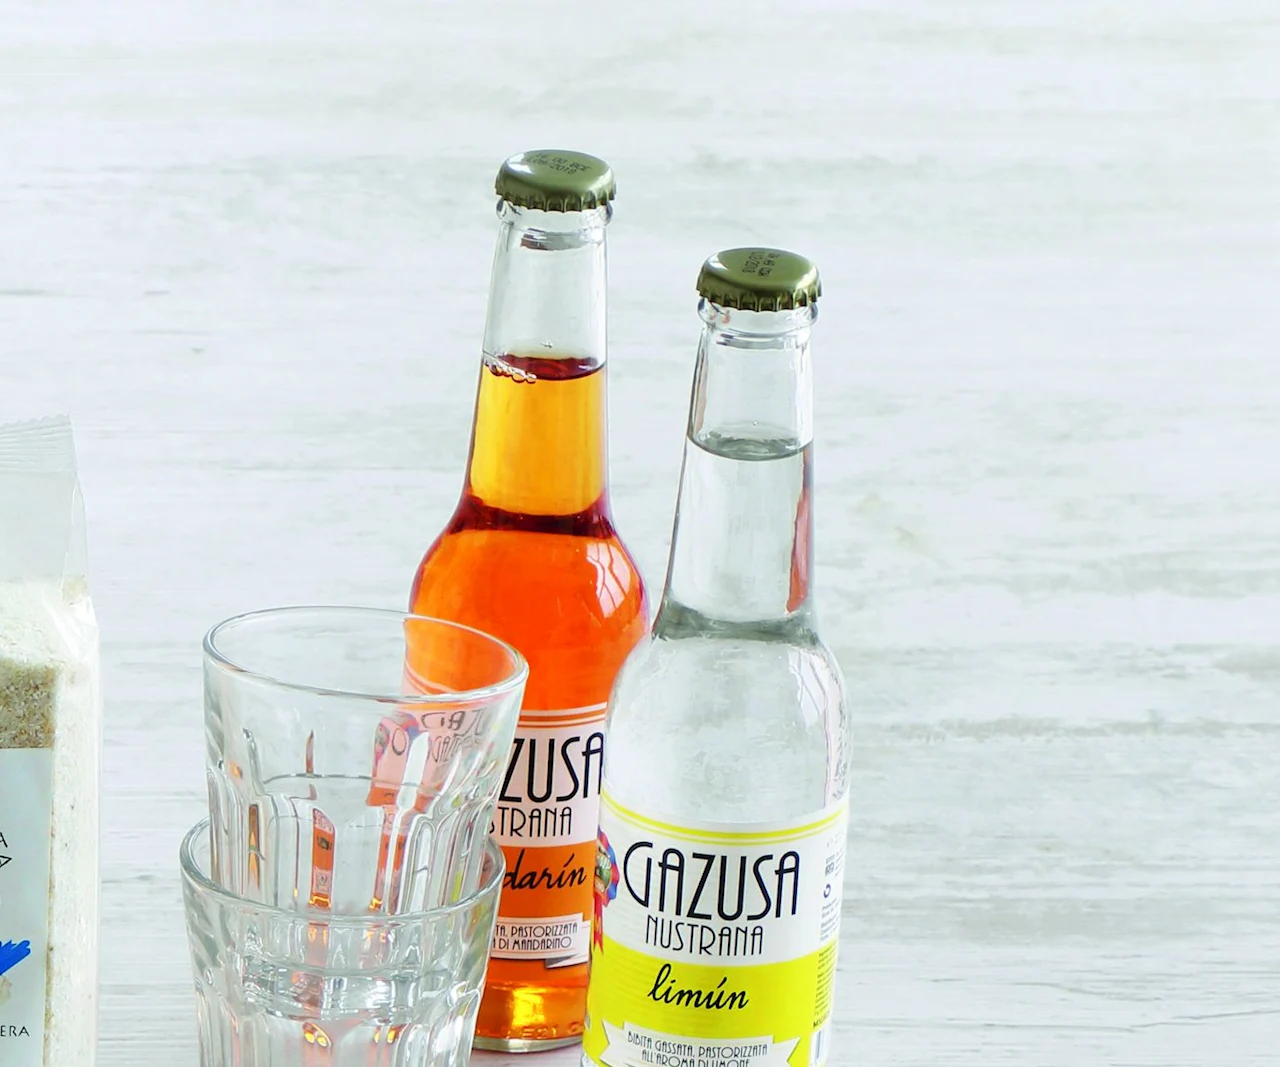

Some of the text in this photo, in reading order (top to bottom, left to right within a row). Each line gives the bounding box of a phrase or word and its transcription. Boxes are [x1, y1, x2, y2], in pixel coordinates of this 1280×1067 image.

[498, 731, 604, 803] ZUSA
[489, 806, 572, 838] TRANA
[503, 848, 587, 890] darín
[623, 841, 801, 921] GAZUSA
[498, 938, 509, 949] DI
[512, 936, 572, 951] MANDARINO
[510, 922, 578, 938] PASTORIZZATA
[645, 916, 764, 956] NUSTRANA
[647, 964, 749, 1010] limún
[627, 1031, 653, 1050] BIBITA
[698, 1043, 768, 1059] PASTORIZZATA
